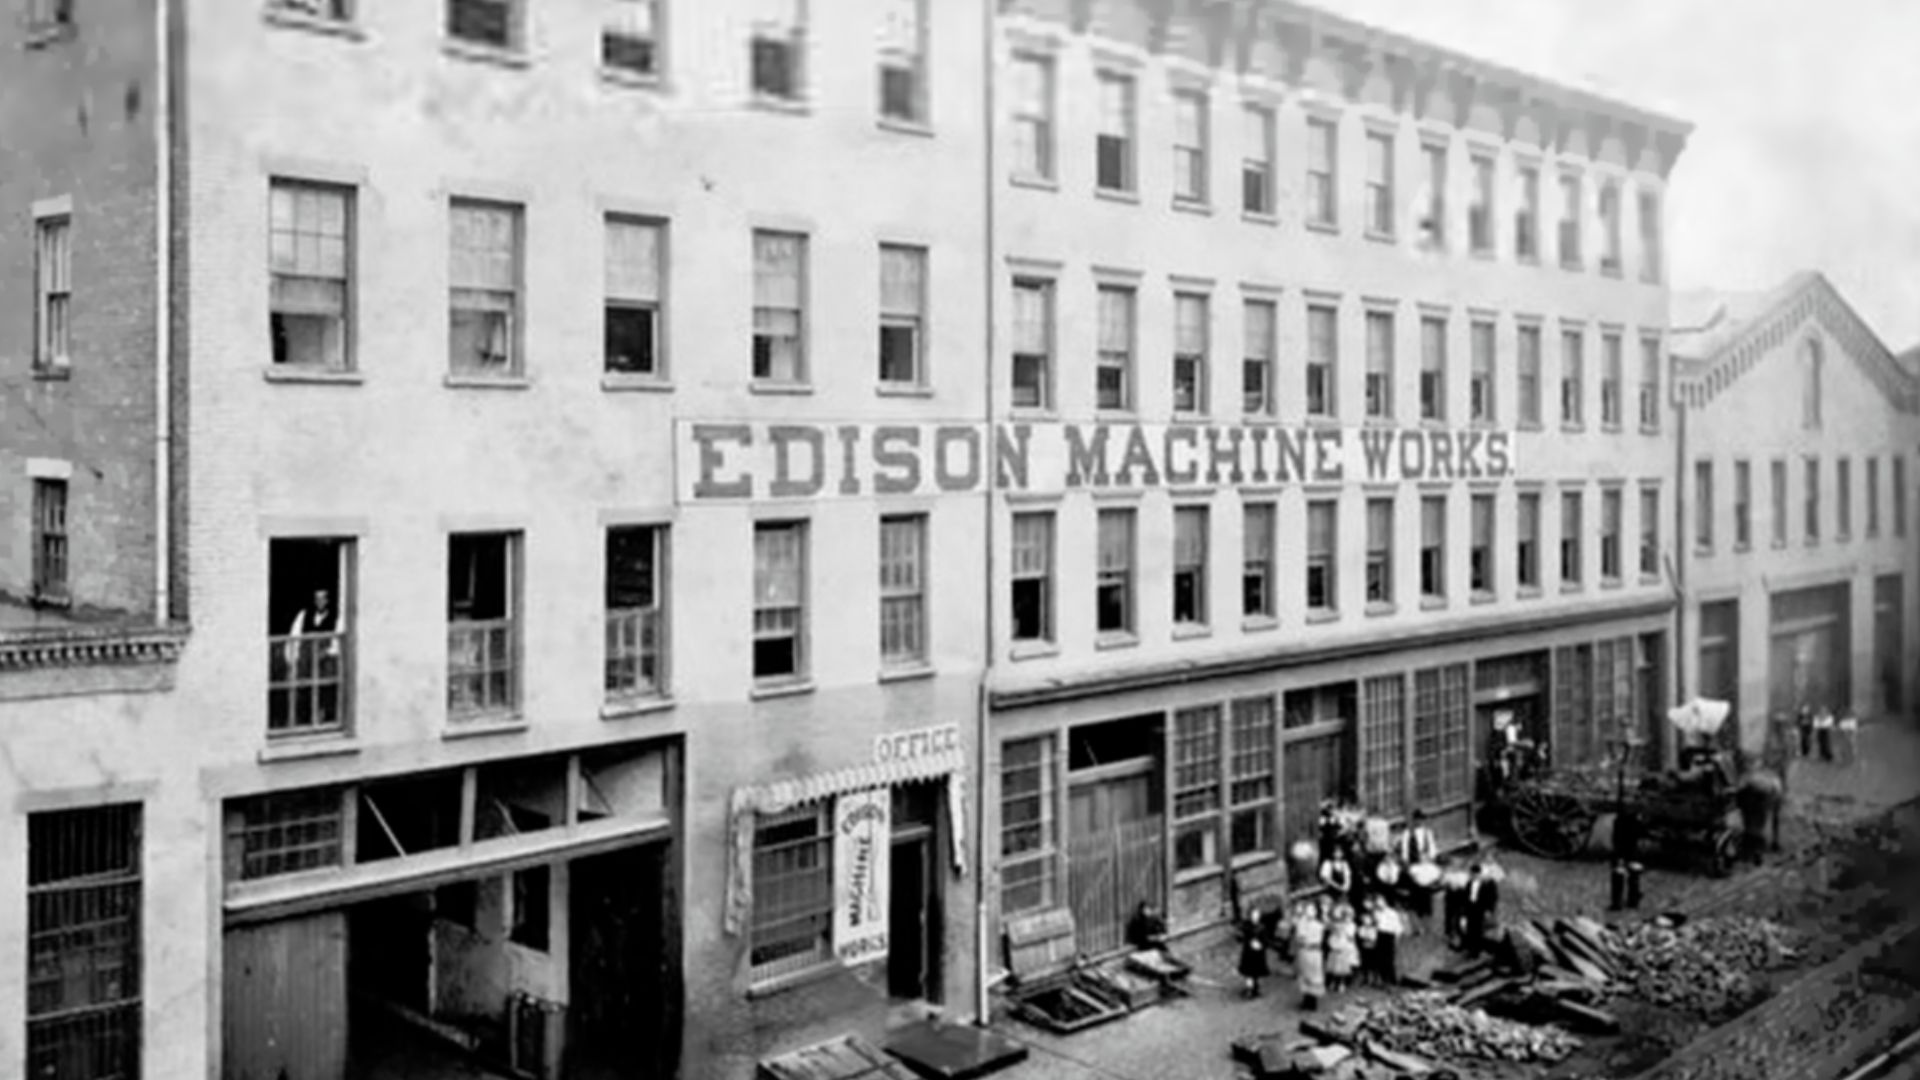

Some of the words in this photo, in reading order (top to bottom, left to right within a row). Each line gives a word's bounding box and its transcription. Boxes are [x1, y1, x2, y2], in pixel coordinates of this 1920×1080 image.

[692, 424, 1032, 498] EDISON
[1065, 425, 1343, 486] MACHINE
[1360, 430, 1515, 479] WORKS.
[877, 726, 957, 762] OFFICE
